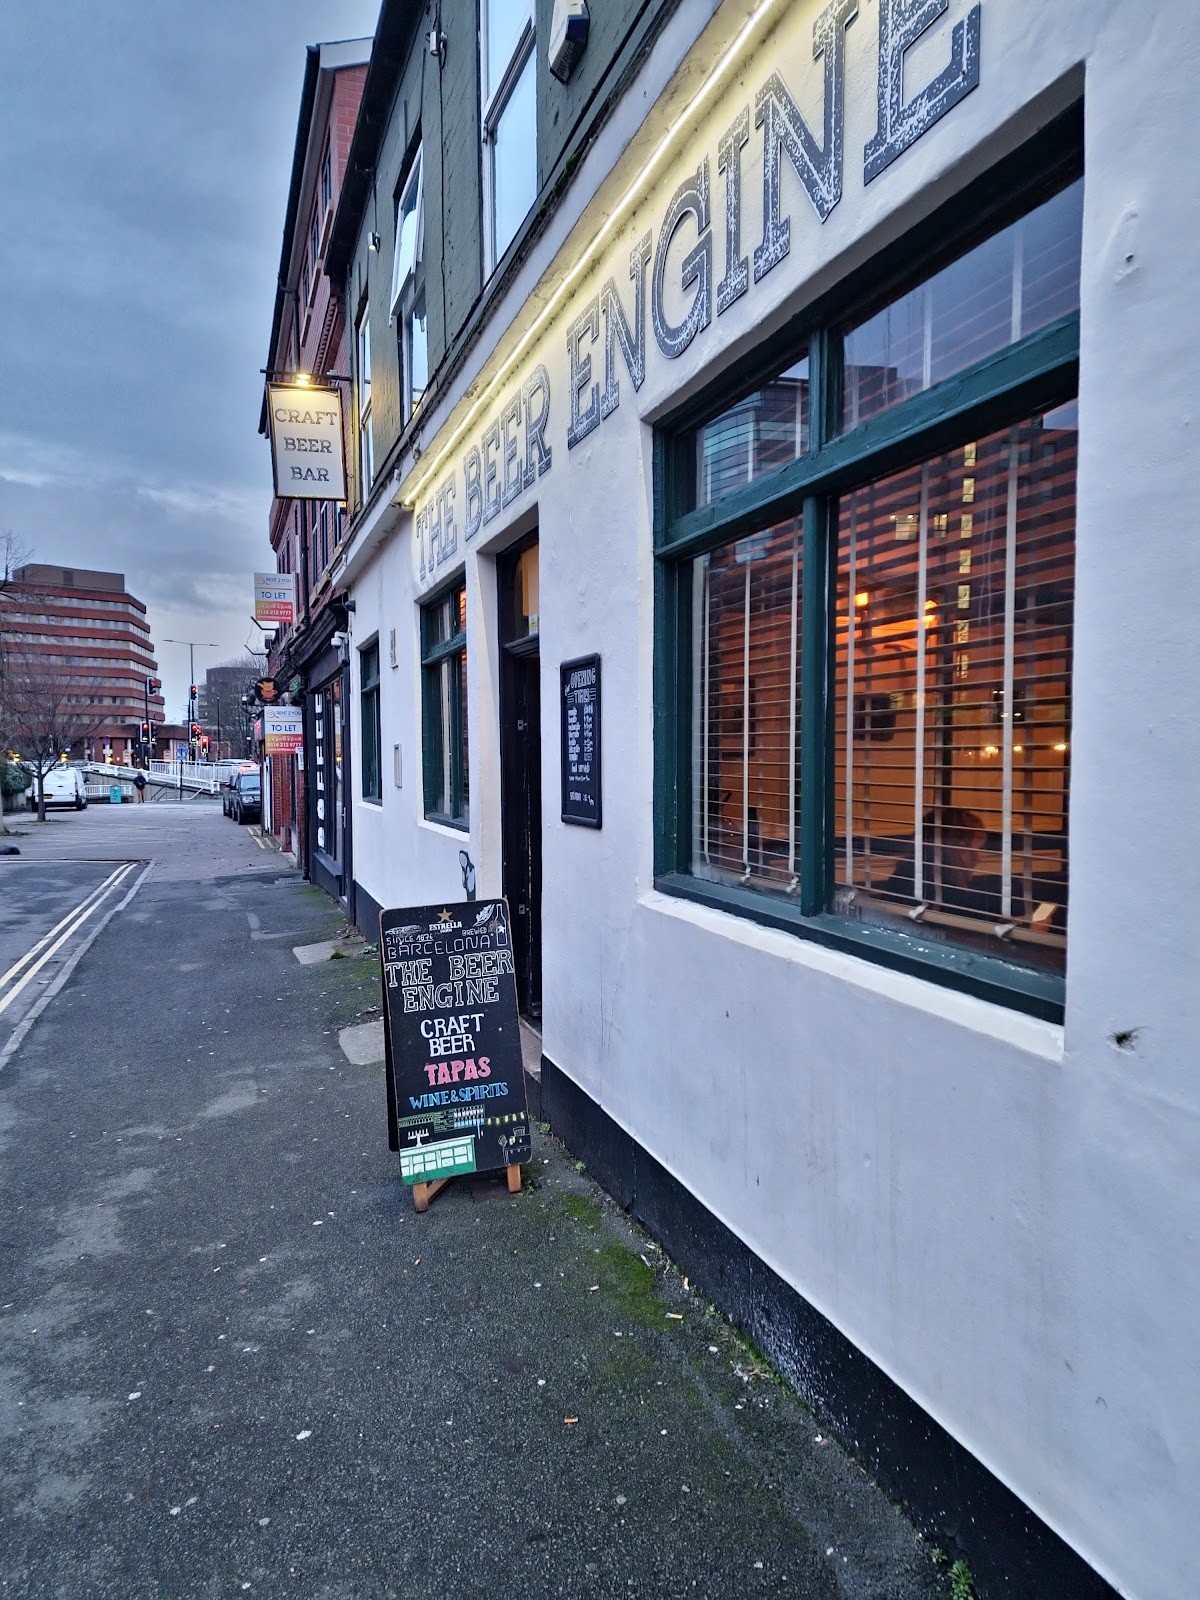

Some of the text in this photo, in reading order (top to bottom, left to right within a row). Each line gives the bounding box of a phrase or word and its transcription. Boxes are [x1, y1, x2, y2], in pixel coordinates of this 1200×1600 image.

[416, 0, 981, 582] THE BEER ENGINE
[274, 408, 337, 426] CRAFT
[283, 436, 332, 454] BEER
[290, 465, 330, 482] BAR
[261, 591, 287, 600] TO LET
[570, 667, 596, 688] OPENING
[271, 724, 296, 732] TO LET
[428, 921, 463, 931] ESTRELLA
[461, 926, 487, 936] BREWED
[386, 935, 413, 946] SINCE
[387, 935, 490, 960] BARCELONA
[385, 950, 514, 988] THE BEER
[403, 976, 500, 1013] ENGINE
[420, 1013, 485, 1039] CRAFT
[429, 1032, 476, 1058] BEER
[423, 1056, 492, 1087] TAPAS
[409, 1081, 509, 1111] WINE&SPIRITS
